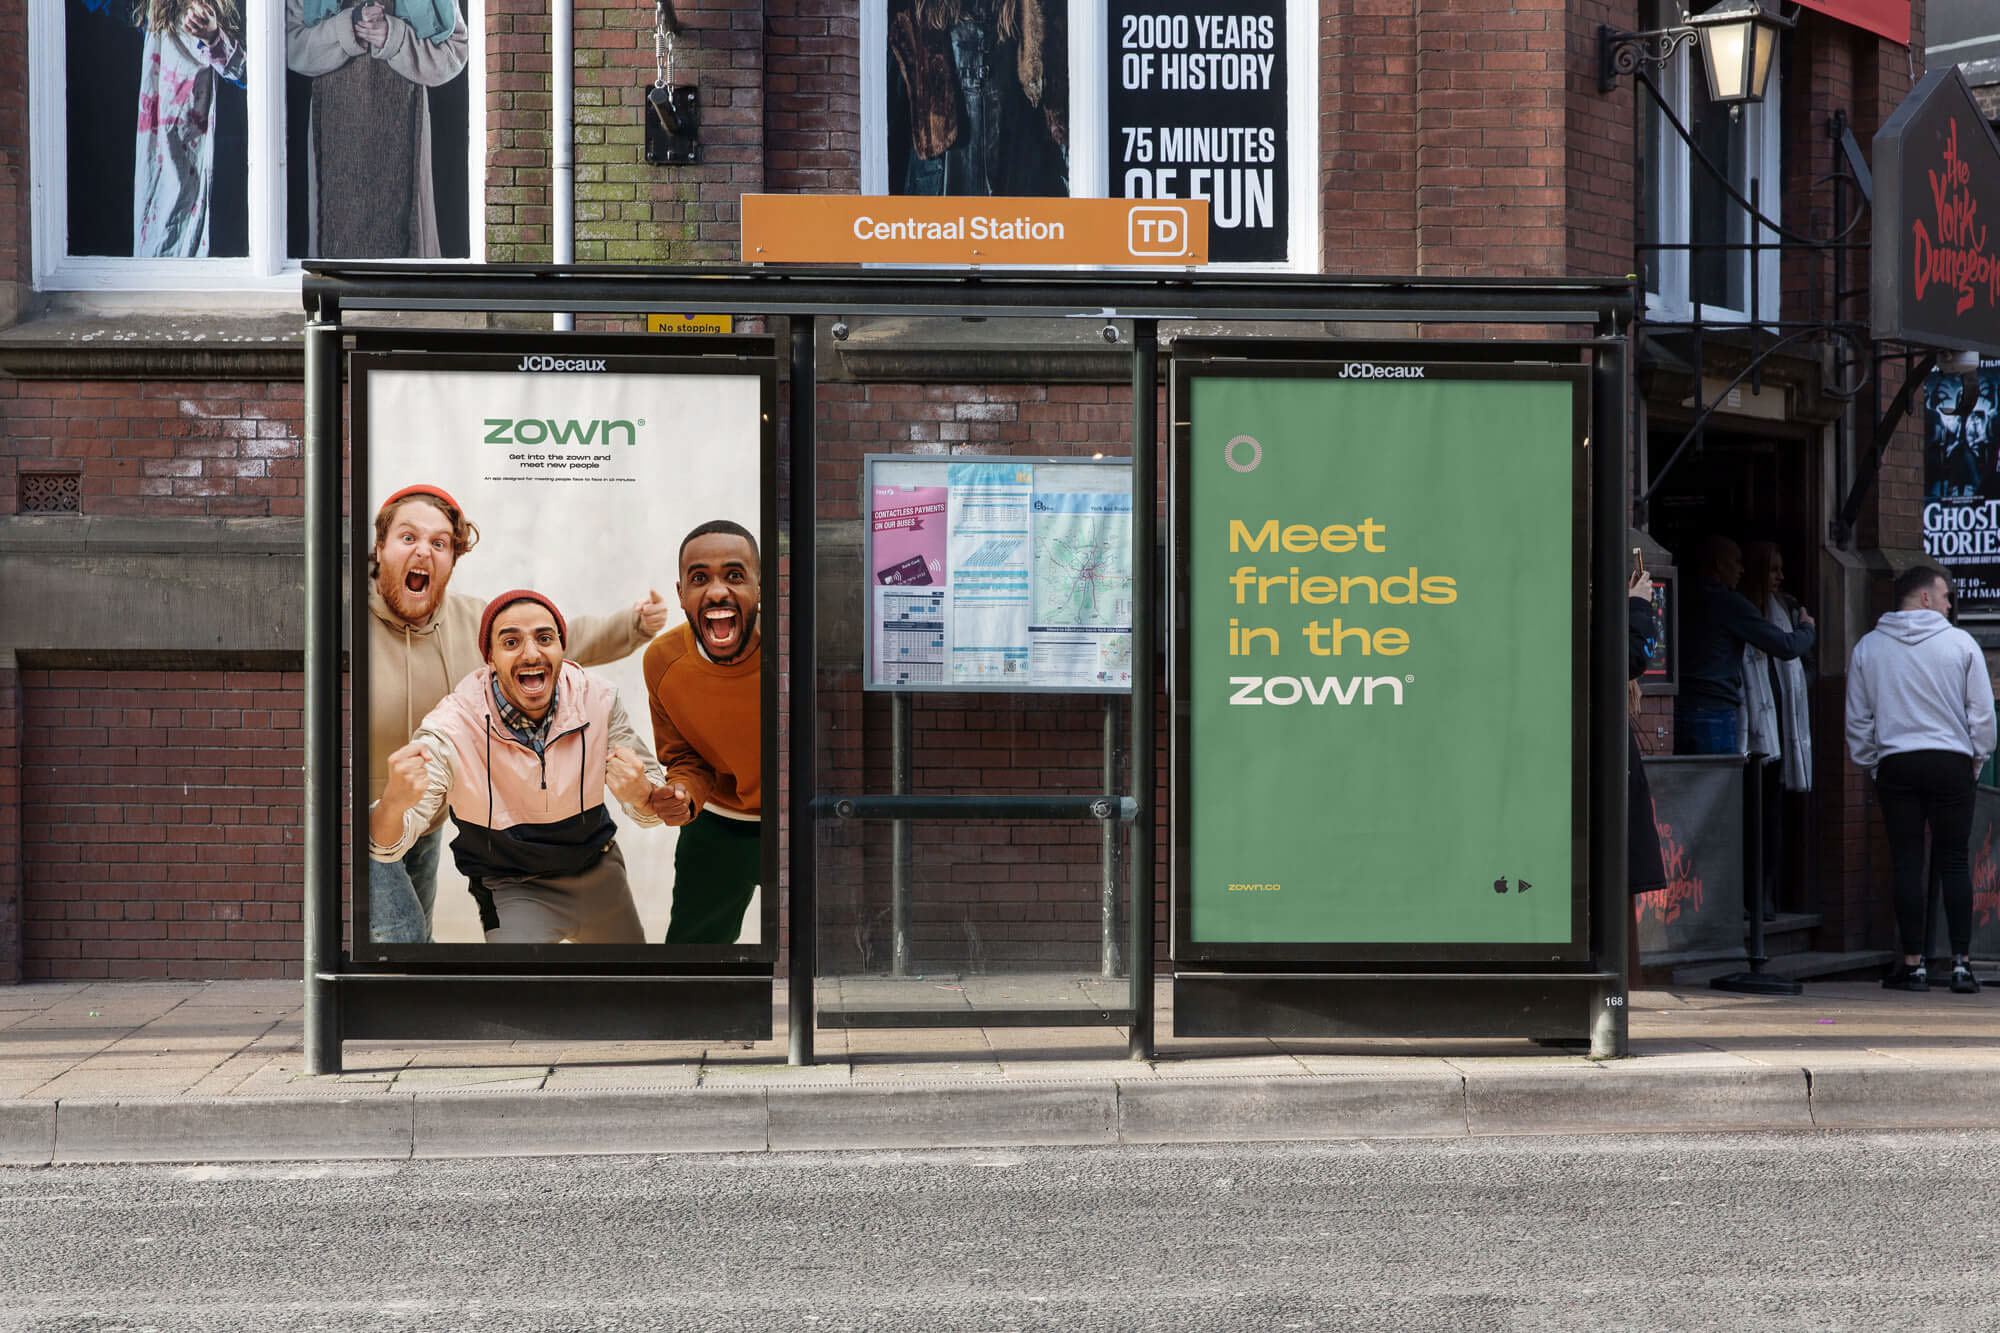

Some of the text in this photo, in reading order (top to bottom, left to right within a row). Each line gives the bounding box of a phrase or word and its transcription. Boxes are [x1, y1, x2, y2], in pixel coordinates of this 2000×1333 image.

[1121, 14, 1275, 49] 2000 YEARS
[1122, 53, 1275, 90] OF HISTORY
[1121, 127, 1276, 163] 75 MINUTES
[1943, 117, 1971, 189] the
[1190, 168, 1274, 229] FUN
[1928, 169, 1987, 253] York
[853, 216, 1065, 240] Centraal Station
[1137, 219, 1178, 243] TD
[1912, 217, 2000, 317] Dungeon
[658, 323, 721, 334] No stopping
[517, 355, 607, 372] JCDecaux
[1338, 362, 1425, 379] JCDecaux
[508, 453, 611, 462] Get into the zown and
[569, 461, 600, 470] people
[874, 503, 945, 520] CONTACTLESS PAYMENTS
[874, 518, 916, 530] ON OUR BUSES
[1923, 500, 2000, 532] GHOST
[1229, 517, 1386, 553] Meet
[1923, 529, 2000, 555] STORIE
[1229, 566, 1458, 605] friends
[1967, 588, 1978, 599] 14
[1229, 618, 1411, 656] in the
[1228, 883, 1281, 892] zown.co
[1604, 996, 1624, 1007] 168
